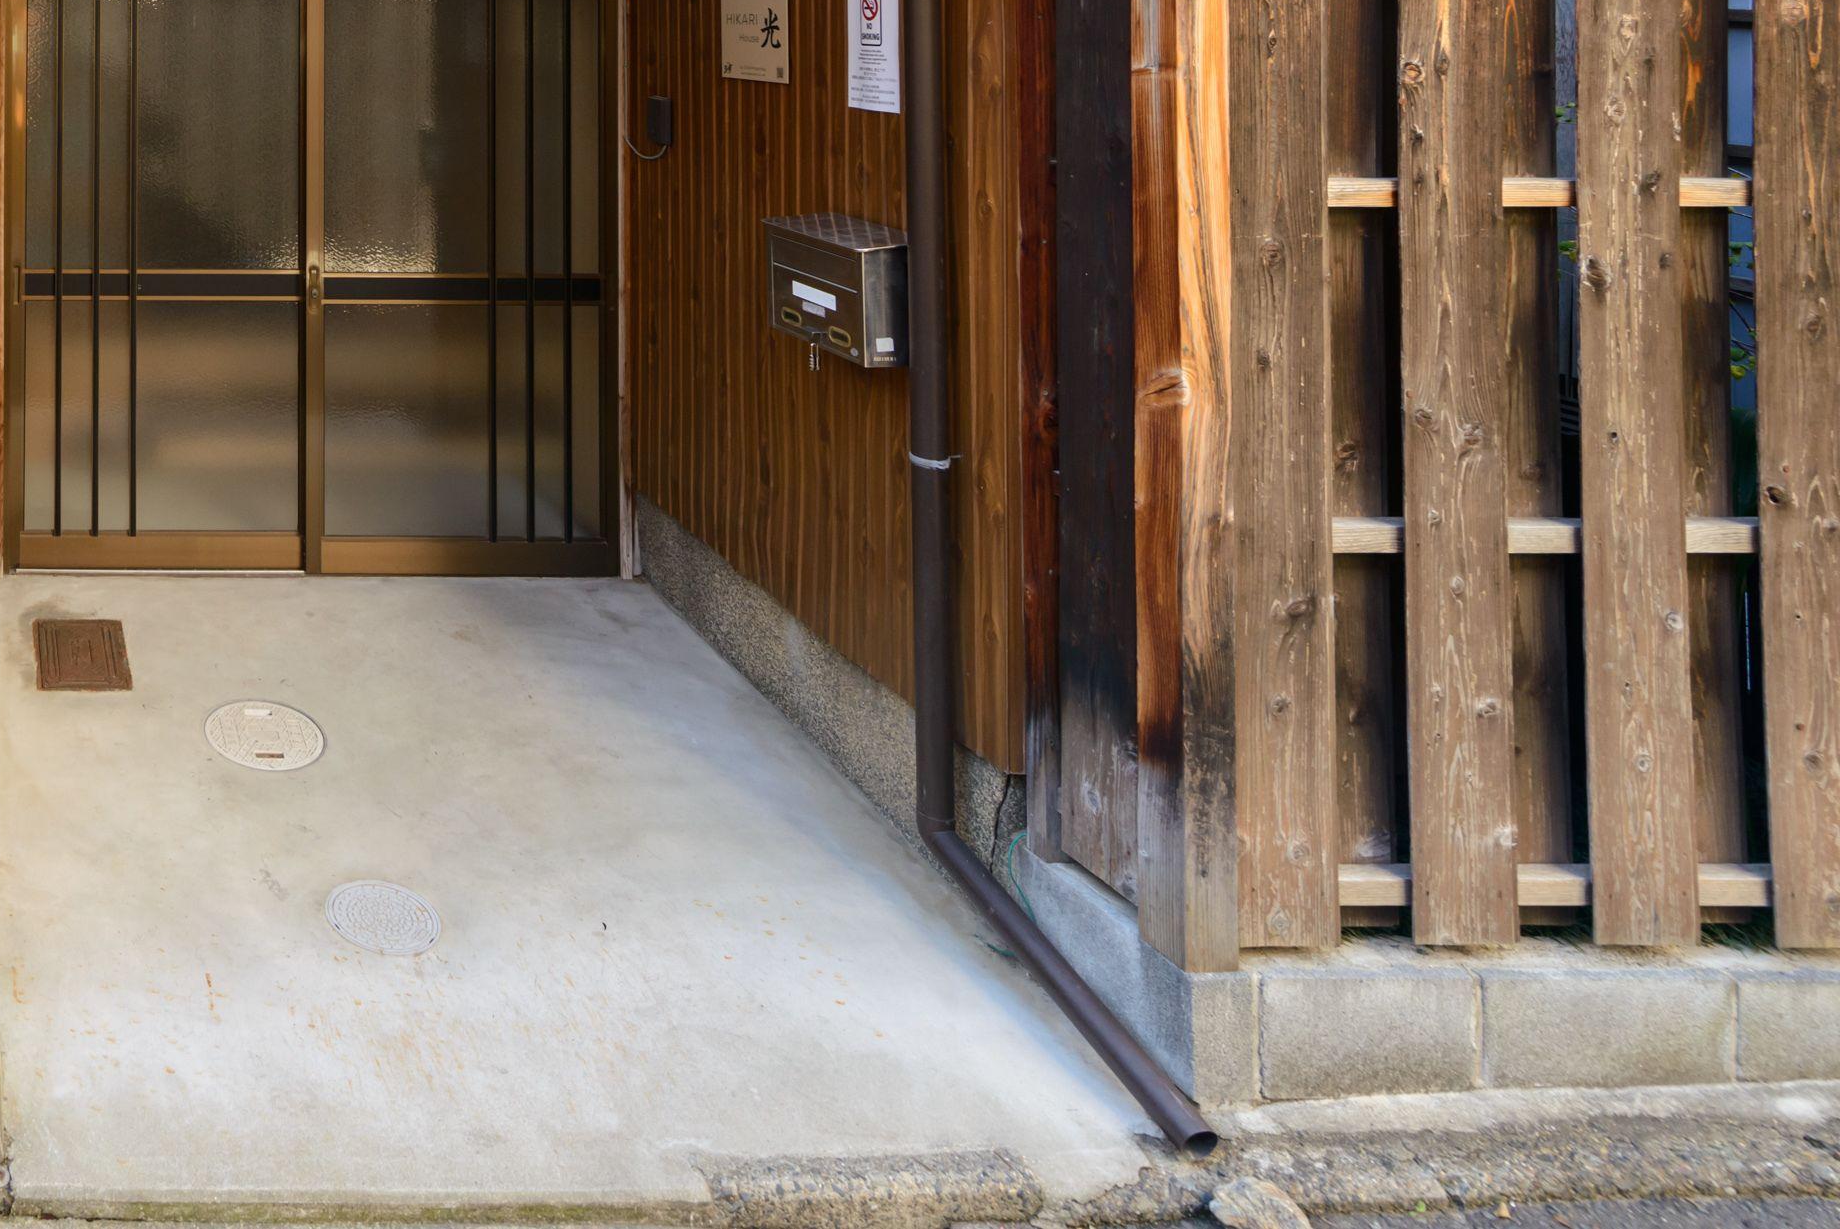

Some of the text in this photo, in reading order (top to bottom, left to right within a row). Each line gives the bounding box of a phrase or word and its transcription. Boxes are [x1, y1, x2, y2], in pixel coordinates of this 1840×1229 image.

[726, 13, 758, 26] HIKARI
[760, 7, 781, 49] 光
[866, 22, 872, 30] NO
[739, 34, 760, 43] House
